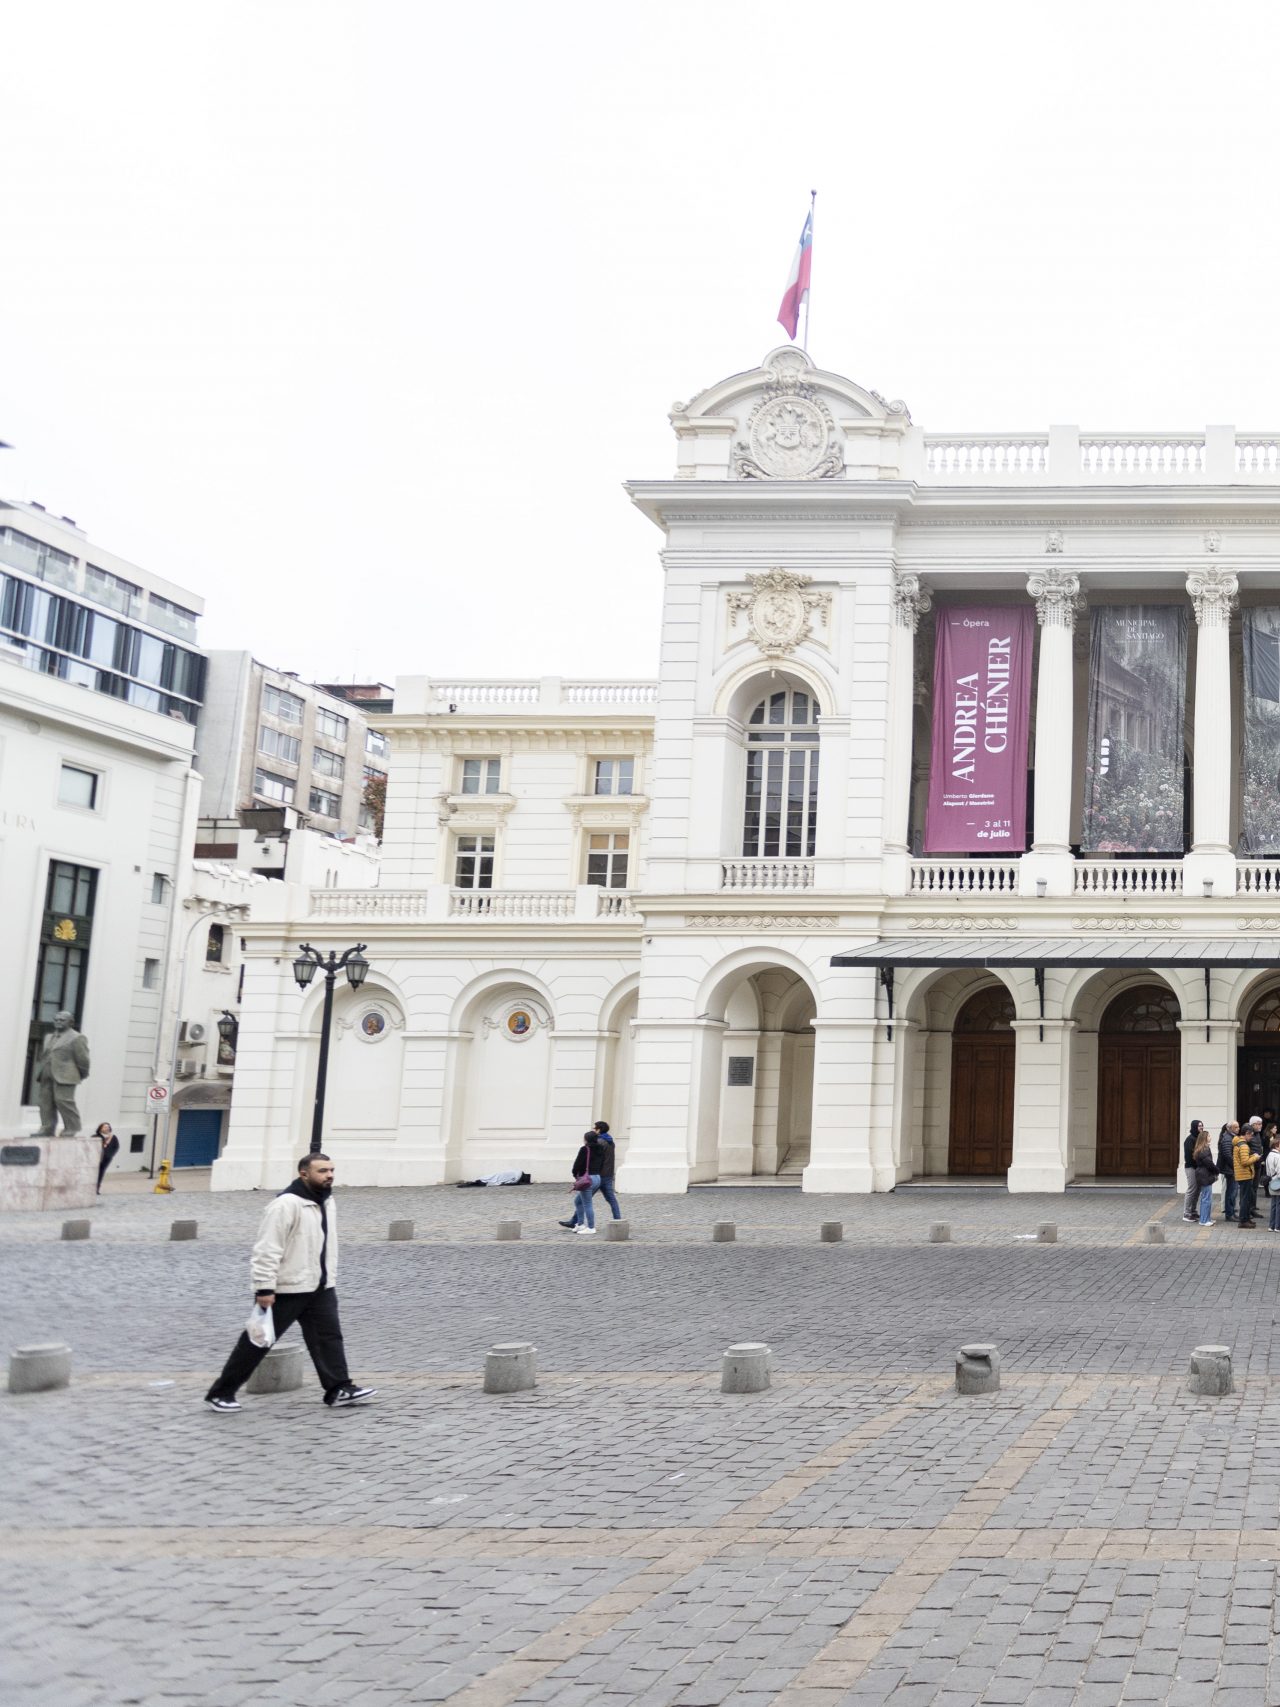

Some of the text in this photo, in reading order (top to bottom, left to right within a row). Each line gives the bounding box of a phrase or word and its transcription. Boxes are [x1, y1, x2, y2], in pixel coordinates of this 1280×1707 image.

[1126, 632, 1165, 640] SANTIAGO
[980, 636, 1011, 753] CHÉNIER
[951, 672, 979, 783] ANDREA
[993, 820, 1001, 828] al
[989, 830, 1011, 839] julio
